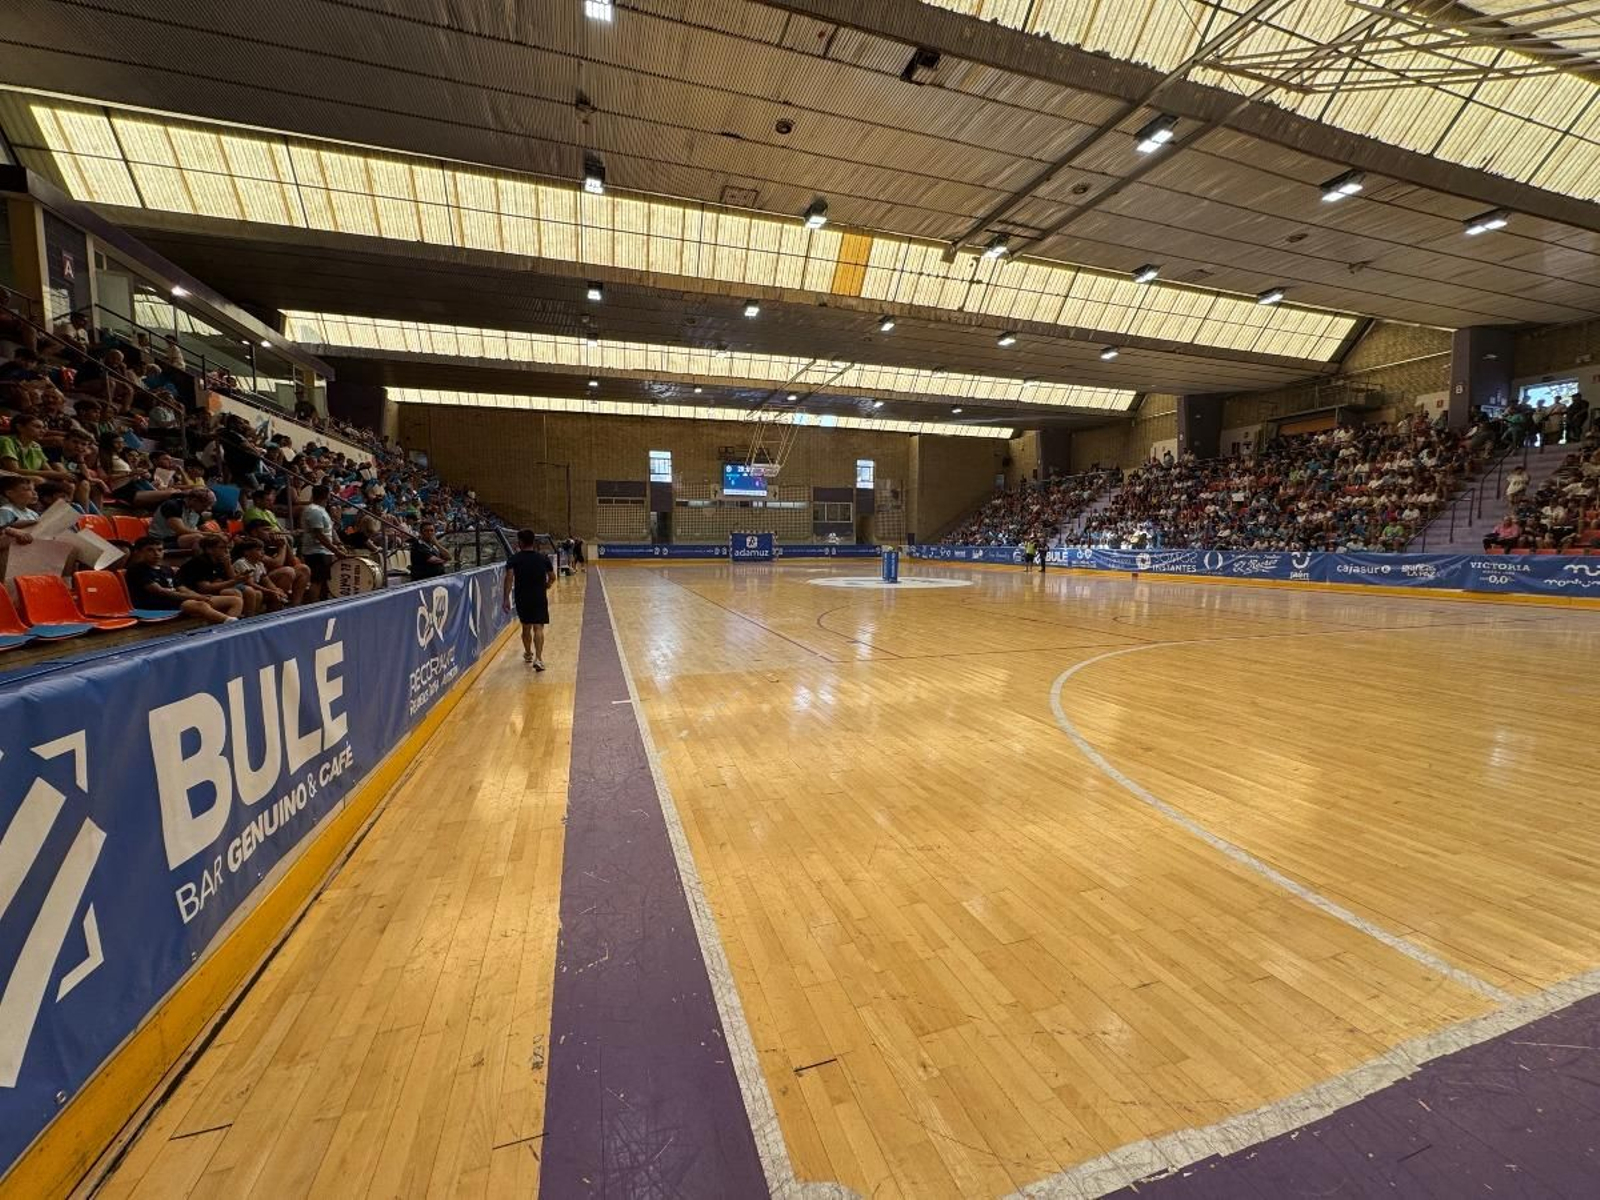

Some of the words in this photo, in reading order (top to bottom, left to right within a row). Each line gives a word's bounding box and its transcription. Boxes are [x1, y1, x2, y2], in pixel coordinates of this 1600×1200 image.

[64, 260, 75, 279] A
[734, 548, 769, 557] adamuz
[1152, 564, 1198, 573] INSTANTES
[1336, 563, 1380, 574] cajasur
[1470, 561, 1531, 572] VICTORIA
[1488, 575, 1509, 585] 0,0
[148, 617, 349, 872] BULÉ
[174, 855, 225, 925] BAR
[227, 780, 307, 874] GENUINO
[307, 772, 318, 799] &
[318, 740, 354, 789] CAFÉ
